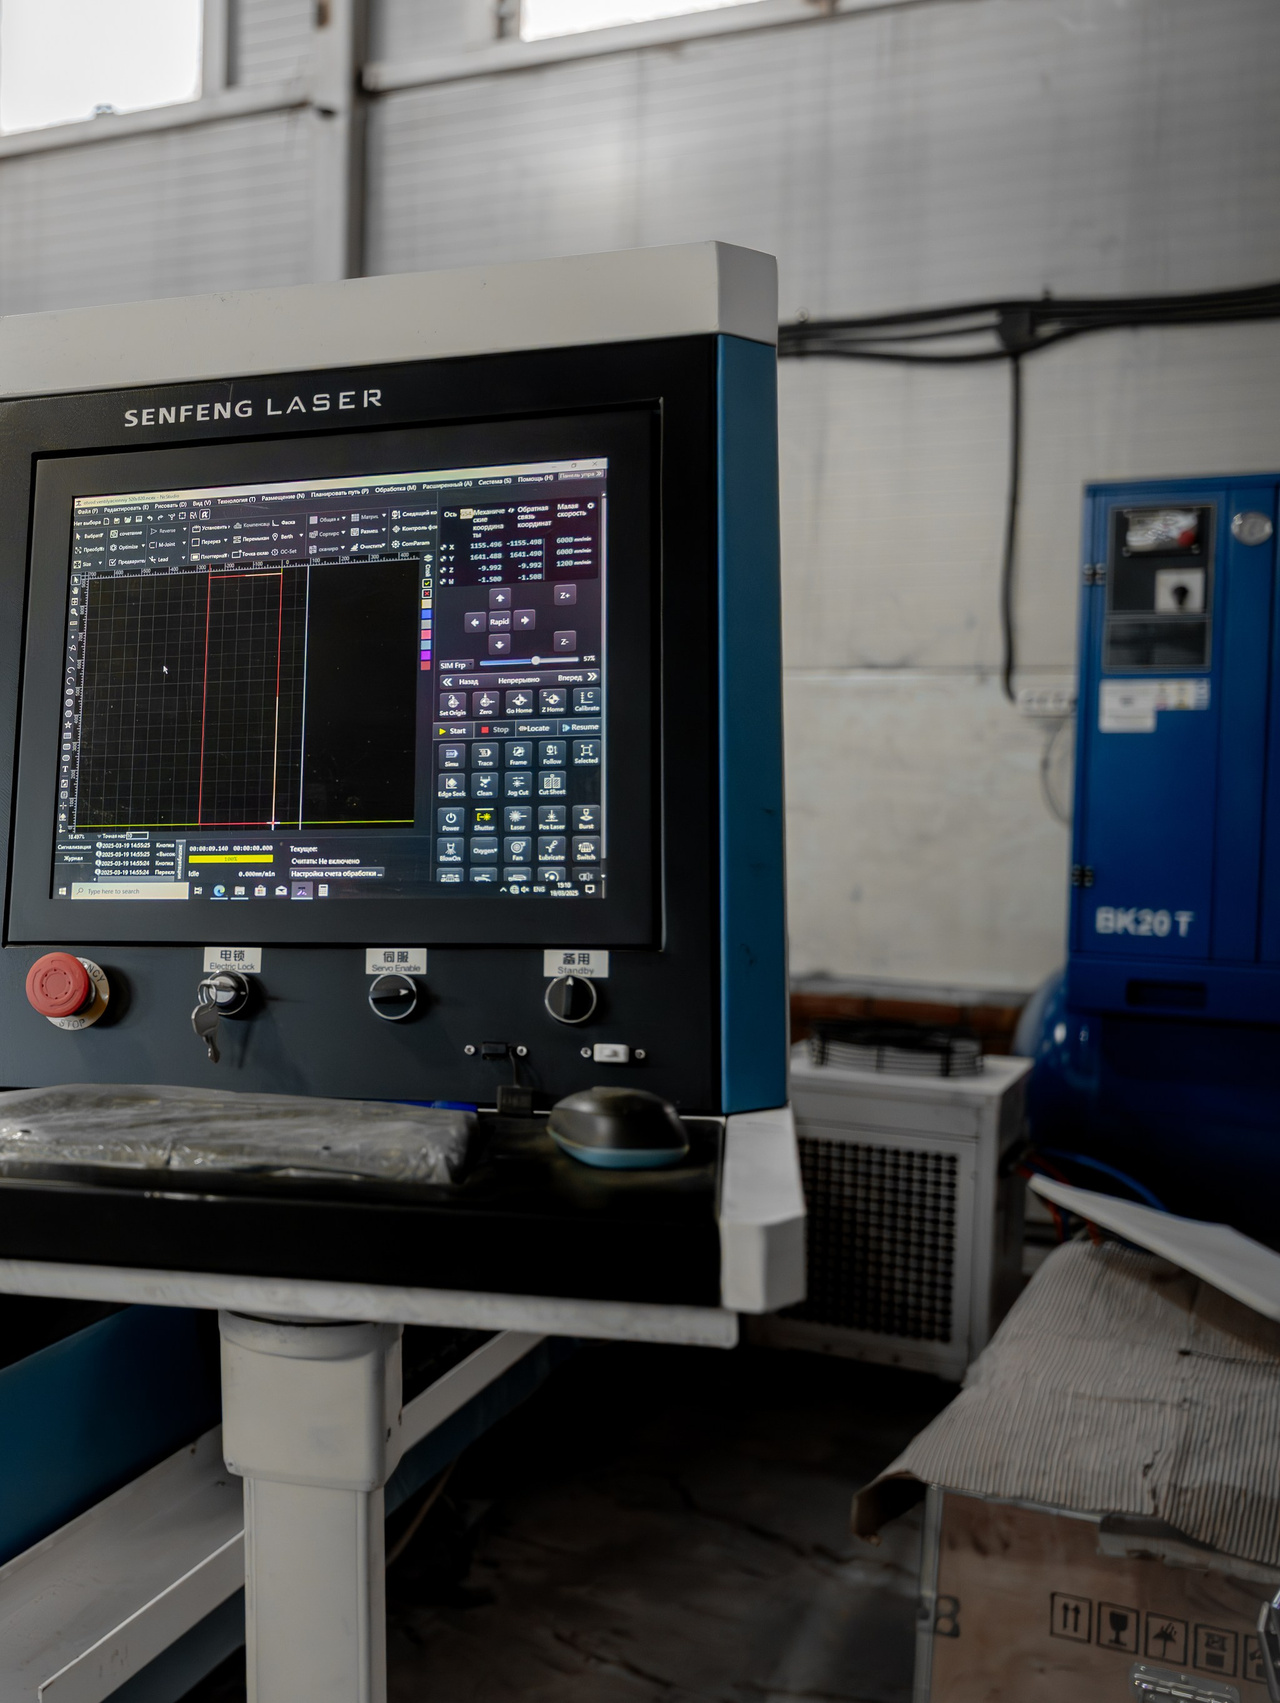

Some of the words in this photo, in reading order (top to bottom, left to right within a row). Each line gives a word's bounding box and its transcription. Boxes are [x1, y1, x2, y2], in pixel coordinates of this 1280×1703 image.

[123, 399, 253, 427] SENFENG
[266, 388, 382, 417] LASER
[422, 481, 463, 490] Расширенный
[478, 478, 503, 486] Система
[261, 494, 295, 502] Размещение
[310, 490, 347, 498] Планировать
[217, 497, 248, 505] Технология
[103, 505, 141, 514] Редактировать
[473, 507, 505, 516] Механиче
[517, 505, 549, 513] Обратная
[443, 510, 457, 518] Ось
[556, 510, 587, 519] скорость
[472, 516, 488, 524] ские
[472, 523, 505, 531] координа
[517, 520, 552, 529] координат
[556, 536, 573, 544] 6000
[518, 562, 542, 570] -9.992
[490, 618, 510, 626] Rapid
[440, 662, 454, 670] SIM
[458, 678, 479, 686] Назад
[498, 676, 540, 685] Непрерывно
[558, 674, 583, 682] Вперед
[449, 709, 467, 717] Origin
[449, 727, 466, 735] Start
[493, 726, 510, 734] Stop
[571, 723, 599, 731] Resume
[438, 790, 452, 798] Edge
[507, 789, 517, 797] Jog
[289, 845, 318, 853] Текущее:
[473, 847, 495, 855] Oxygen
[291, 857, 318, 866] Считать:
[328, 858, 361, 866] включено
[291, 870, 324, 878] Настройка
[342, 870, 377, 878] обработки
[533, 885, 546, 893] ENG
[1095, 906, 1172, 938] BK20
[1174, 911, 1194, 938] T
[220, 950, 245, 961] 电锁
[383, 951, 409, 963] 伺服
[563, 953, 590, 965] 备用
[209, 962, 236, 970] Electric
[372, 964, 394, 972] Servo
[395, 964, 421, 972] Enable
[557, 966, 594, 975] Standby
[58, 1018, 86, 1028] STOP
